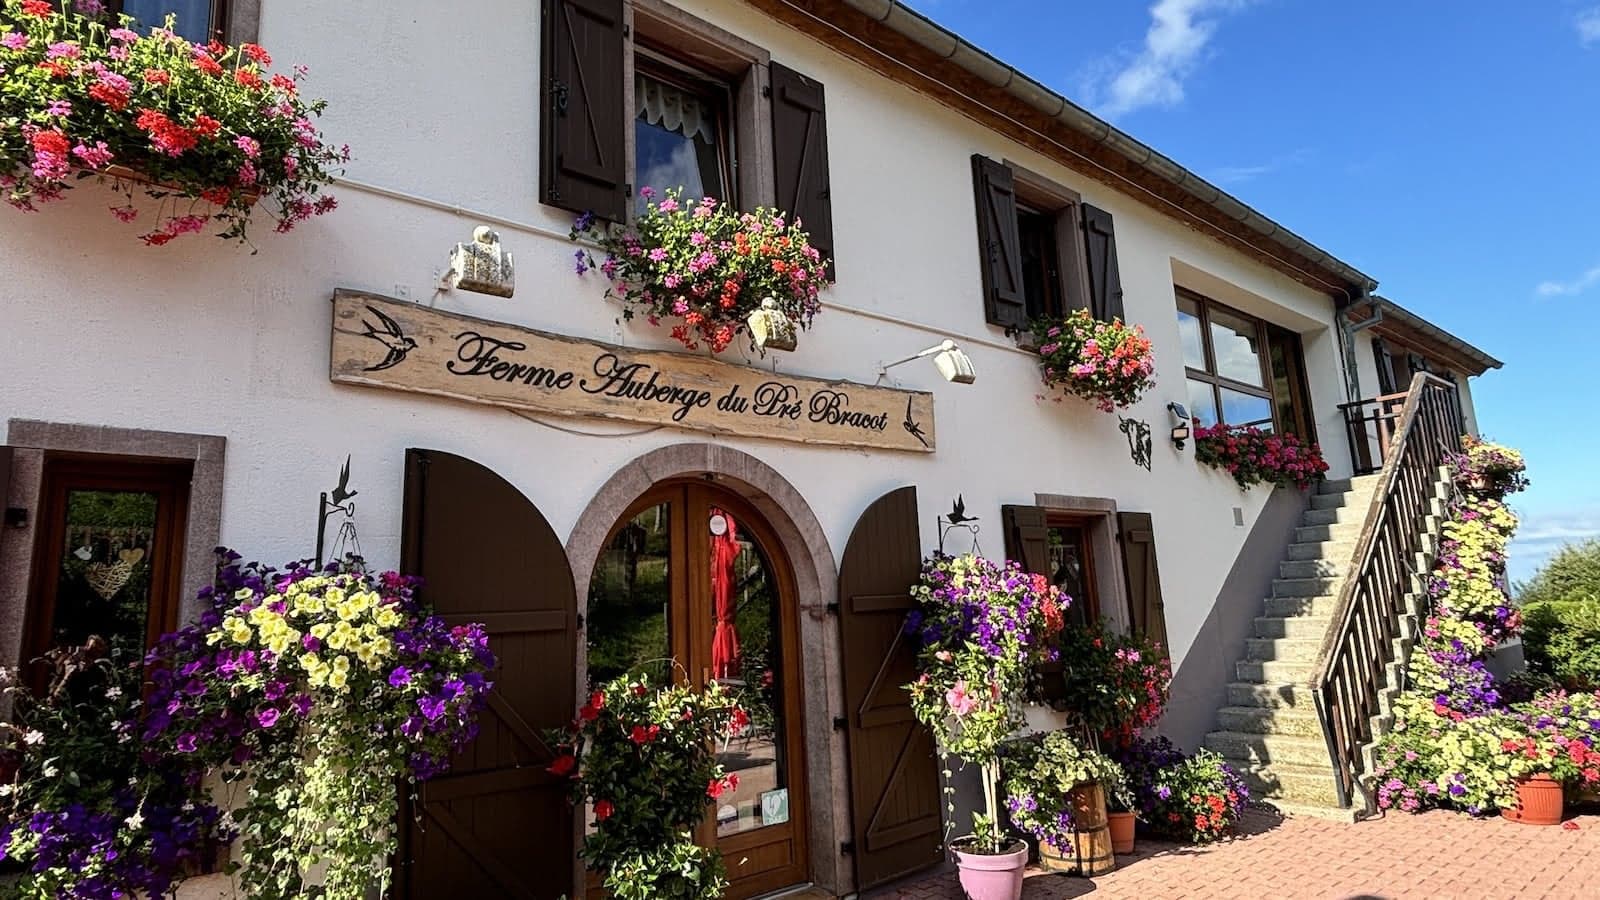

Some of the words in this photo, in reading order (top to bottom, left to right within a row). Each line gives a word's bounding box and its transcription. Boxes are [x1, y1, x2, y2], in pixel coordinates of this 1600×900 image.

[446, 331, 574, 390] Ferme
[579, 353, 711, 422] Auberge
[717, 385, 749, 413] du
[752, 382, 801, 420] Pré
[808, 390, 888, 431] Bracot
